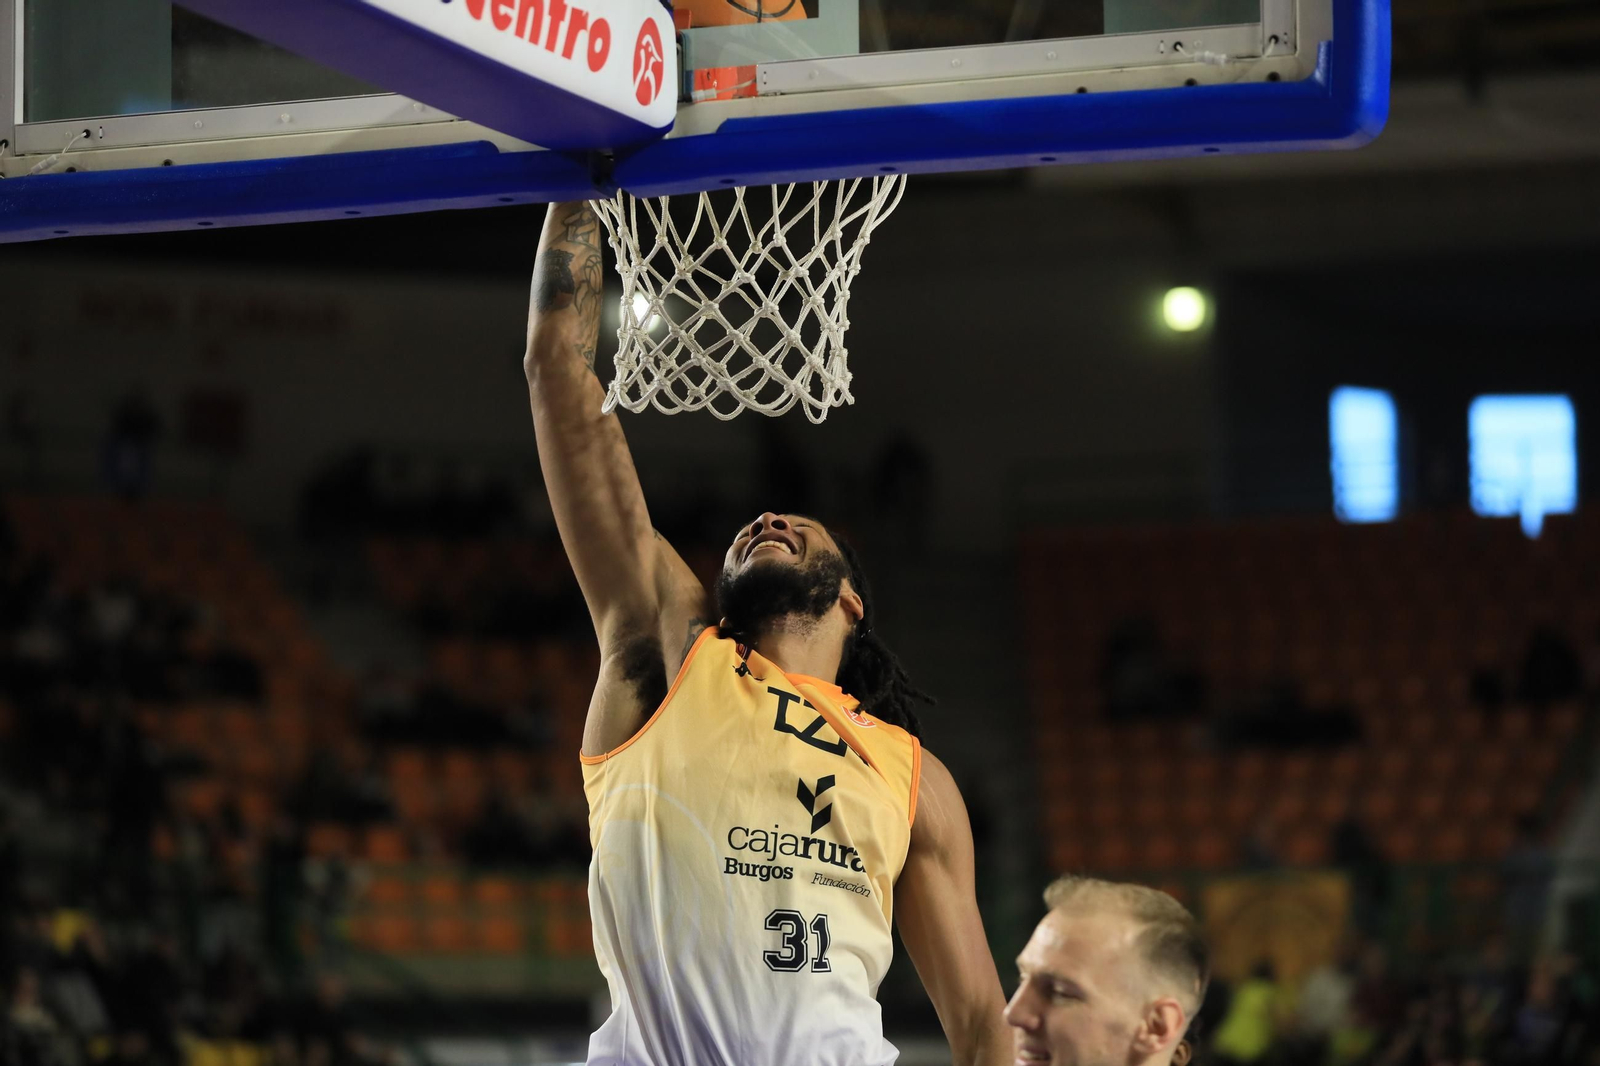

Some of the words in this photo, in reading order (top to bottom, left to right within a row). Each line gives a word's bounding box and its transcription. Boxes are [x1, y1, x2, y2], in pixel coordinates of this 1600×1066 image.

[723, 856, 794, 882] Burgos
[810, 872, 871, 898] Fundación
[763, 909, 832, 973] 31
